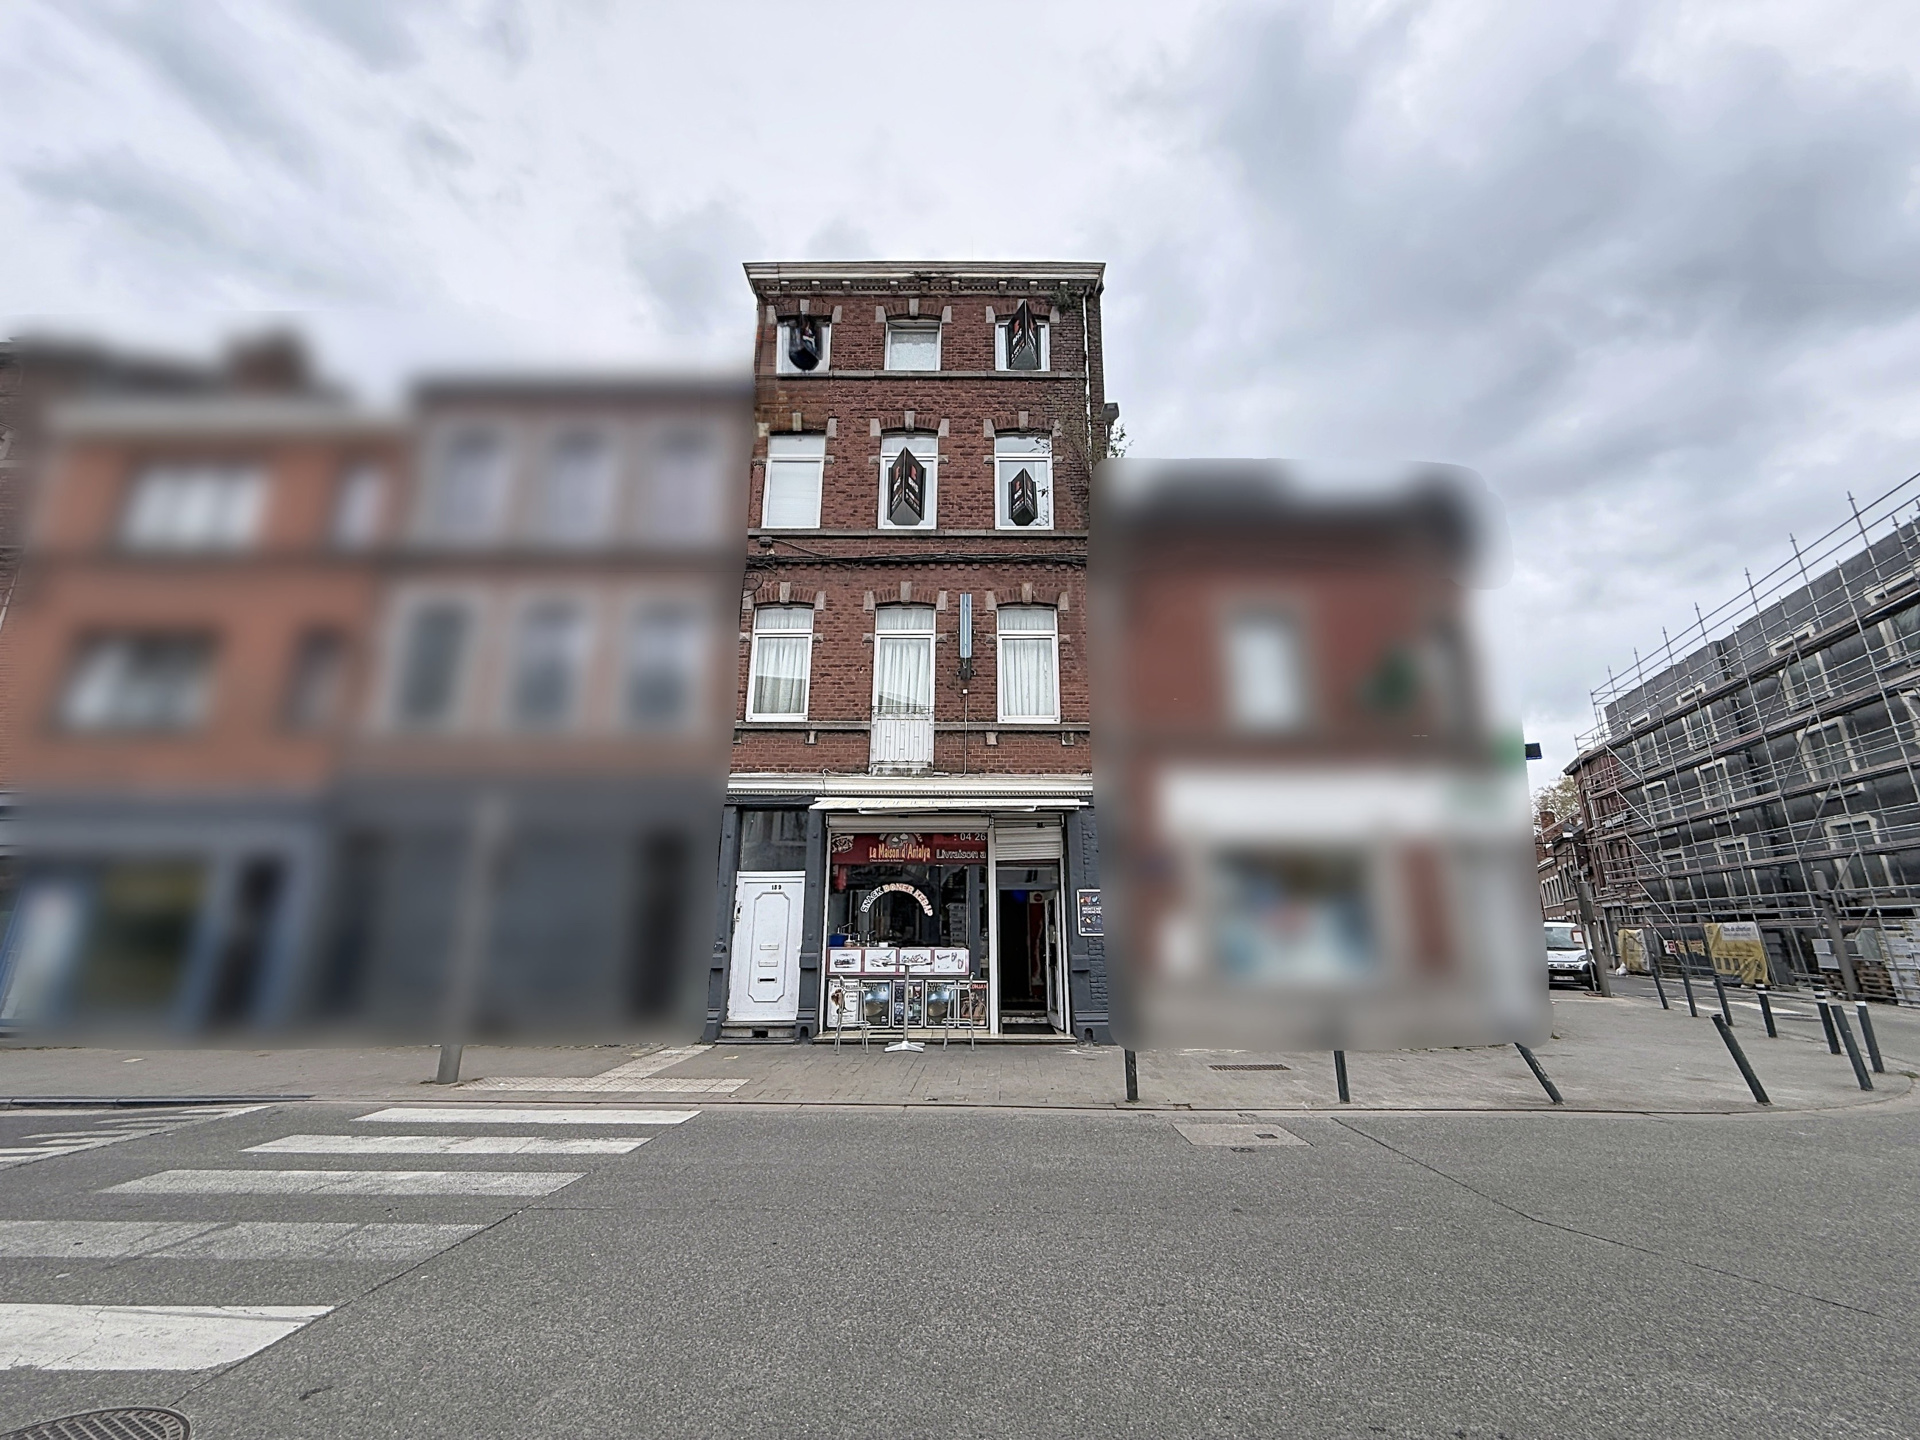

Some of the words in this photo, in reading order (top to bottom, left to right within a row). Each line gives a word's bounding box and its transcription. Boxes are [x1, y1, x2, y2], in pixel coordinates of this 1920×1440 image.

[960, 833, 971, 841] 04
[869, 846, 877, 859] La
[878, 843, 900, 859] Maison
[936, 849, 979, 859] Livraison
[860, 887, 883, 913] SNACK
[913, 889, 933, 916] KEBAP
